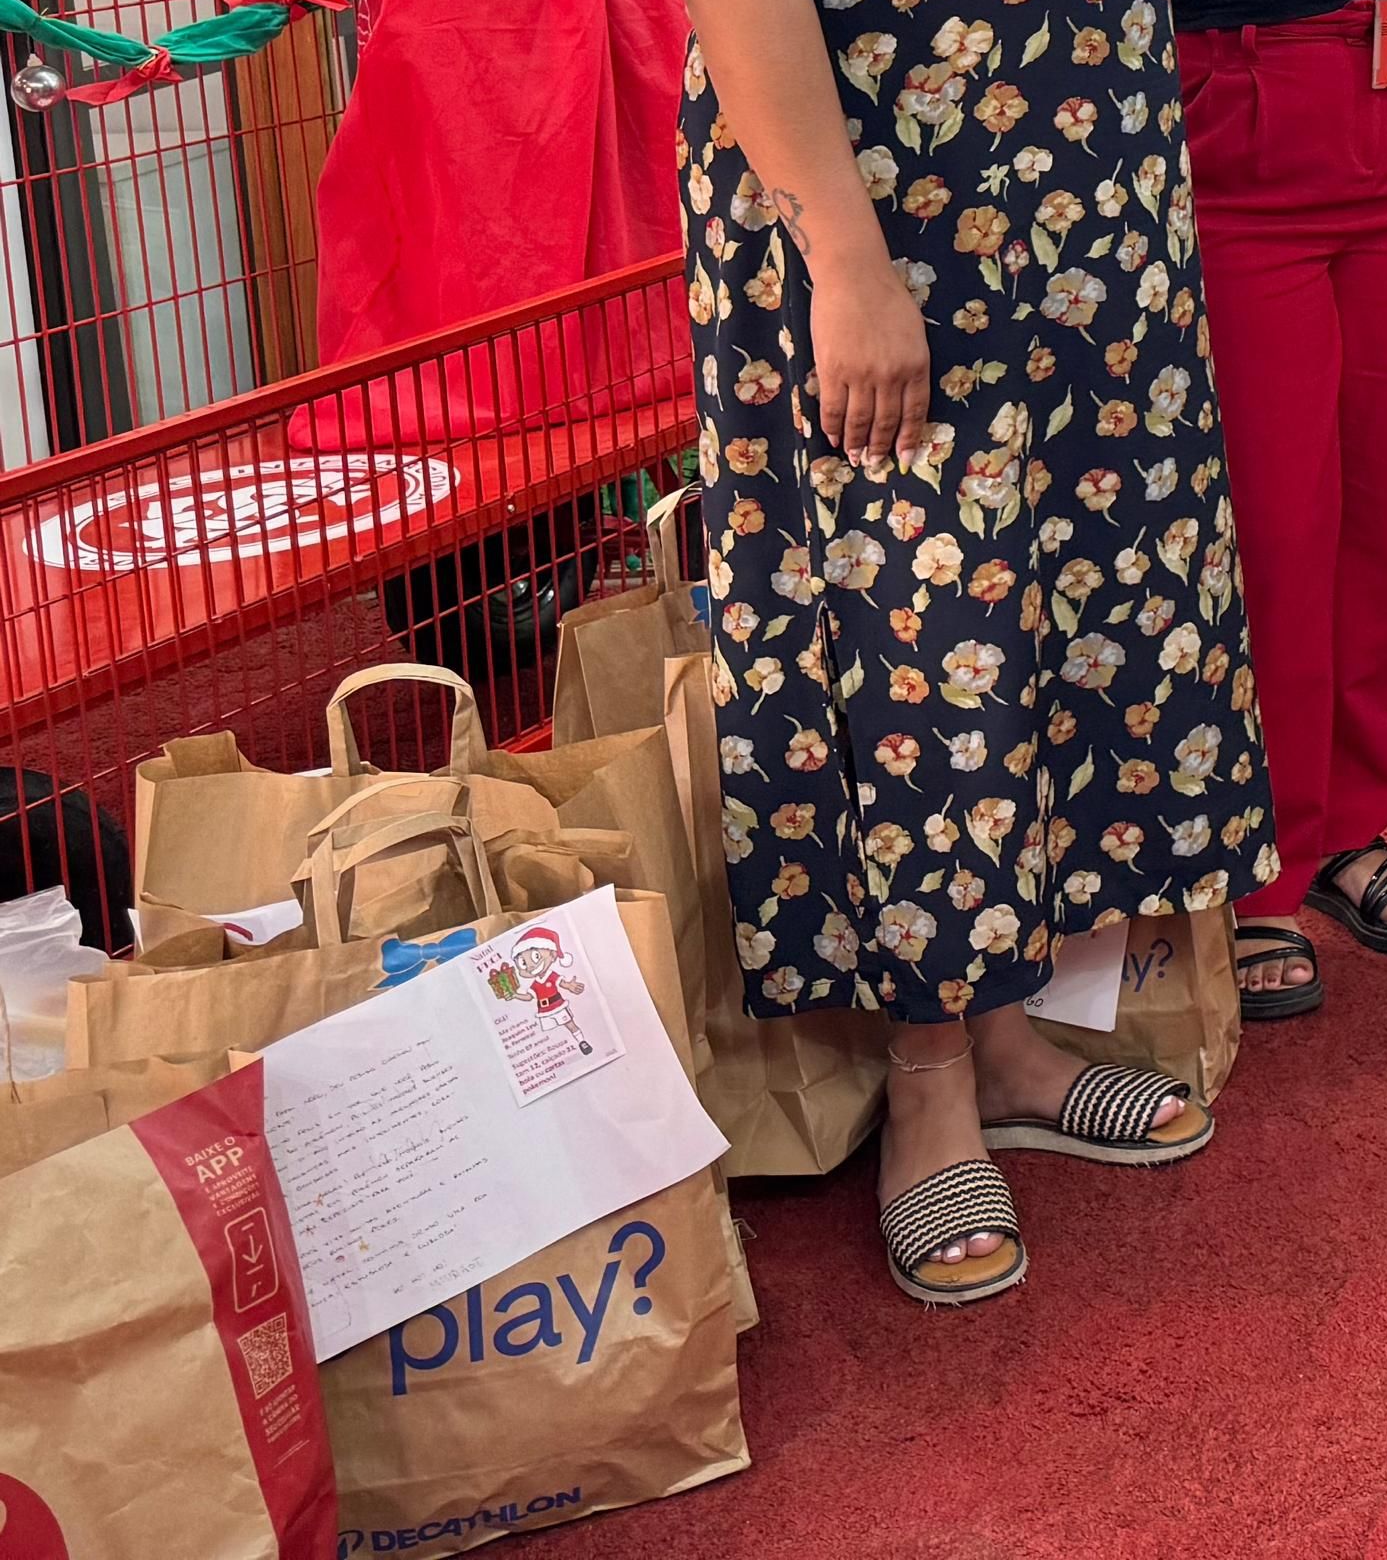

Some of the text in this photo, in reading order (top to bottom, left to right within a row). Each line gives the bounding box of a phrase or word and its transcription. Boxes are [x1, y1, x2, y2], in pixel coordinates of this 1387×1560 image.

[185, 1136, 235, 1167] BAIXE O
[195, 1146, 245, 1184] APP
[389, 1220, 666, 1396] play?
[371, 1486, 582, 1553] DECATHLON
